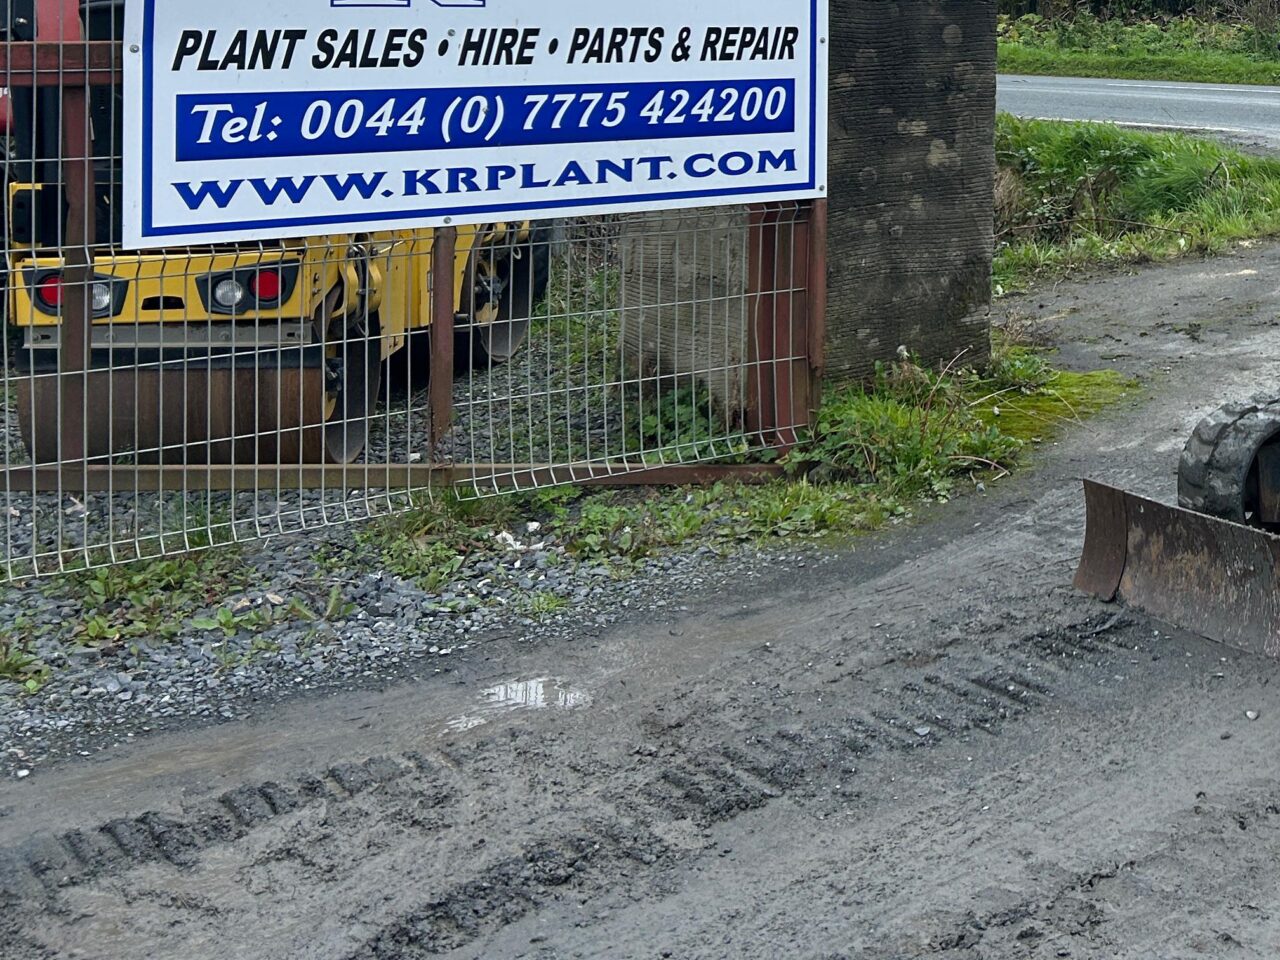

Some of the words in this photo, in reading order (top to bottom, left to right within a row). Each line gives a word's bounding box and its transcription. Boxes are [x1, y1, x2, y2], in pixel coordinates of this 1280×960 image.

[171, 29, 306, 71] PLANT
[311, 28, 428, 69] SALES
[457, 27, 540, 66] HIRE
[566, 27, 665, 64] PARTS
[671, 26, 691, 63] &
[700, 26, 799, 62] REPAIR
[191, 102, 284, 143] Tel:
[300, 97, 426, 140] 0044
[441, 95, 505, 142] (0)
[523, 91, 630, 131] 7775
[639, 86, 787, 129] 424200
[171, 149, 798, 210] WWW.KRPLANT.COM
